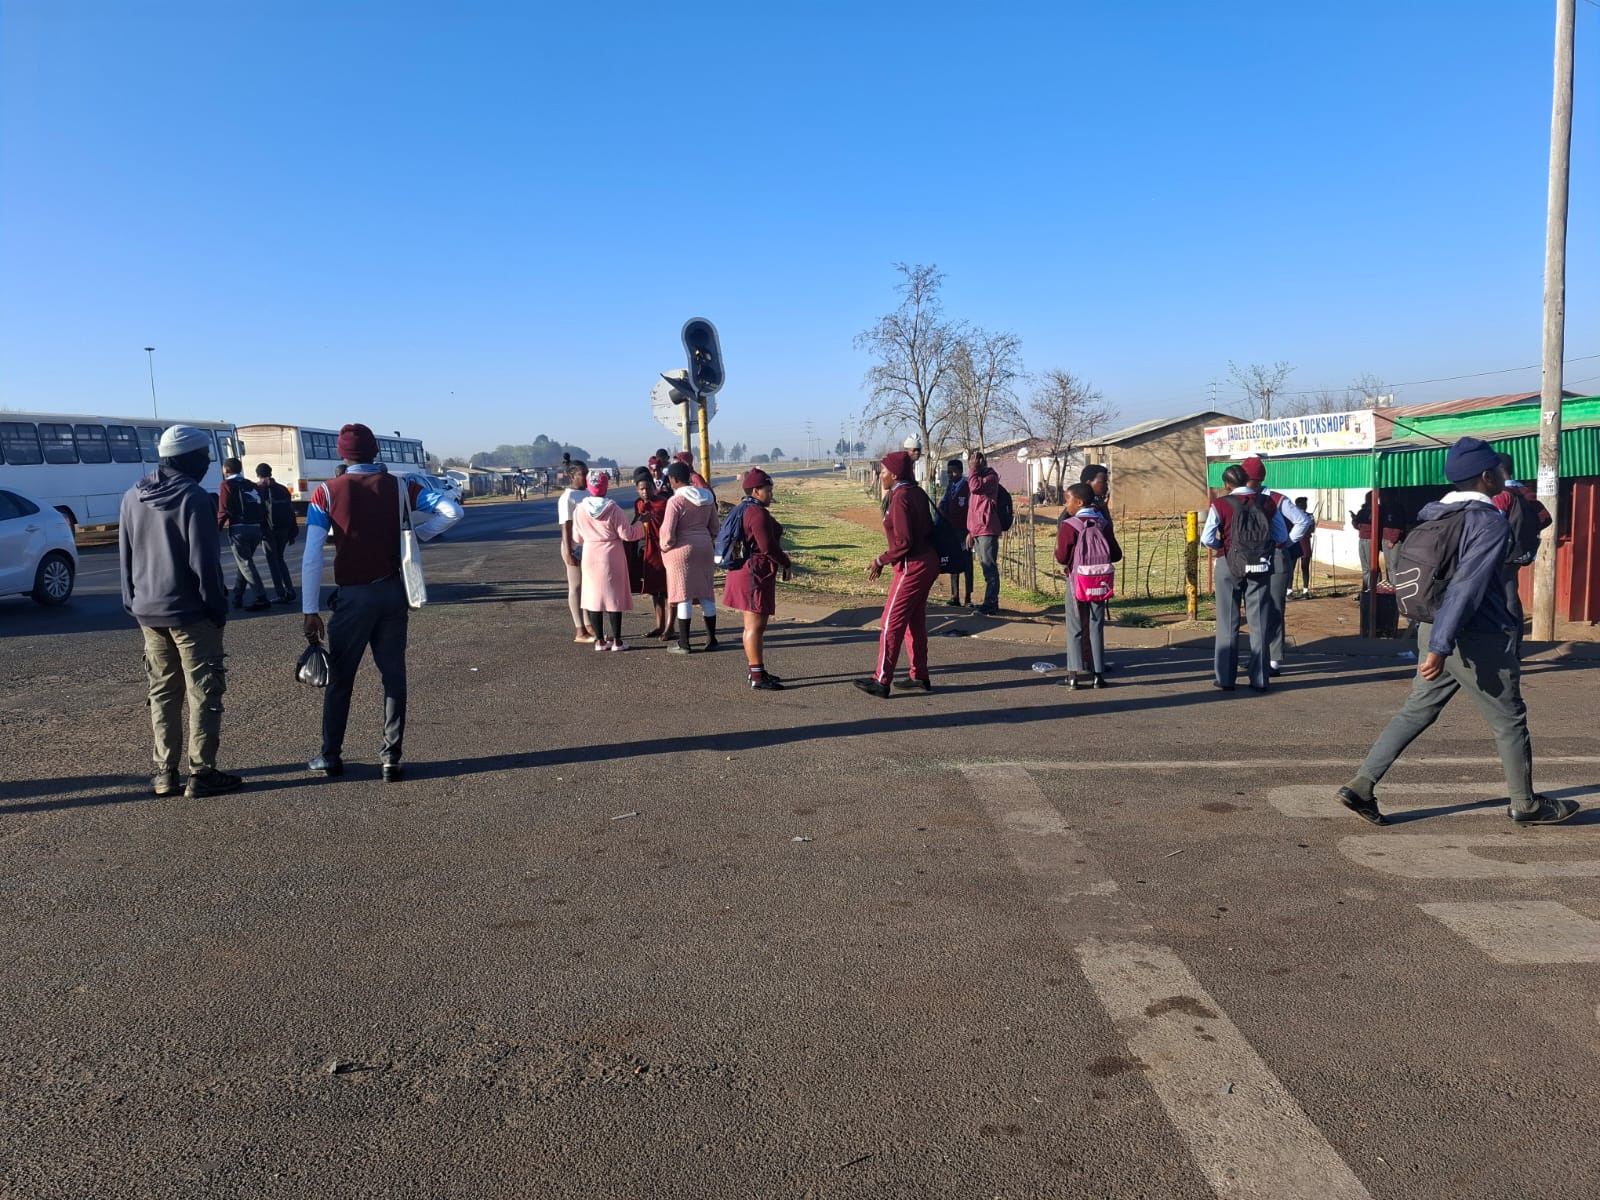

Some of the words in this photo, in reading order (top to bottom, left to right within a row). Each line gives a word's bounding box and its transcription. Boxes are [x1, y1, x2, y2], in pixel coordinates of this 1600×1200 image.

[1245, 421, 1291, 440] ELECTRONICS
[1293, 422, 1299, 436] &
[1300, 415, 1344, 435] TUCKSHOP
